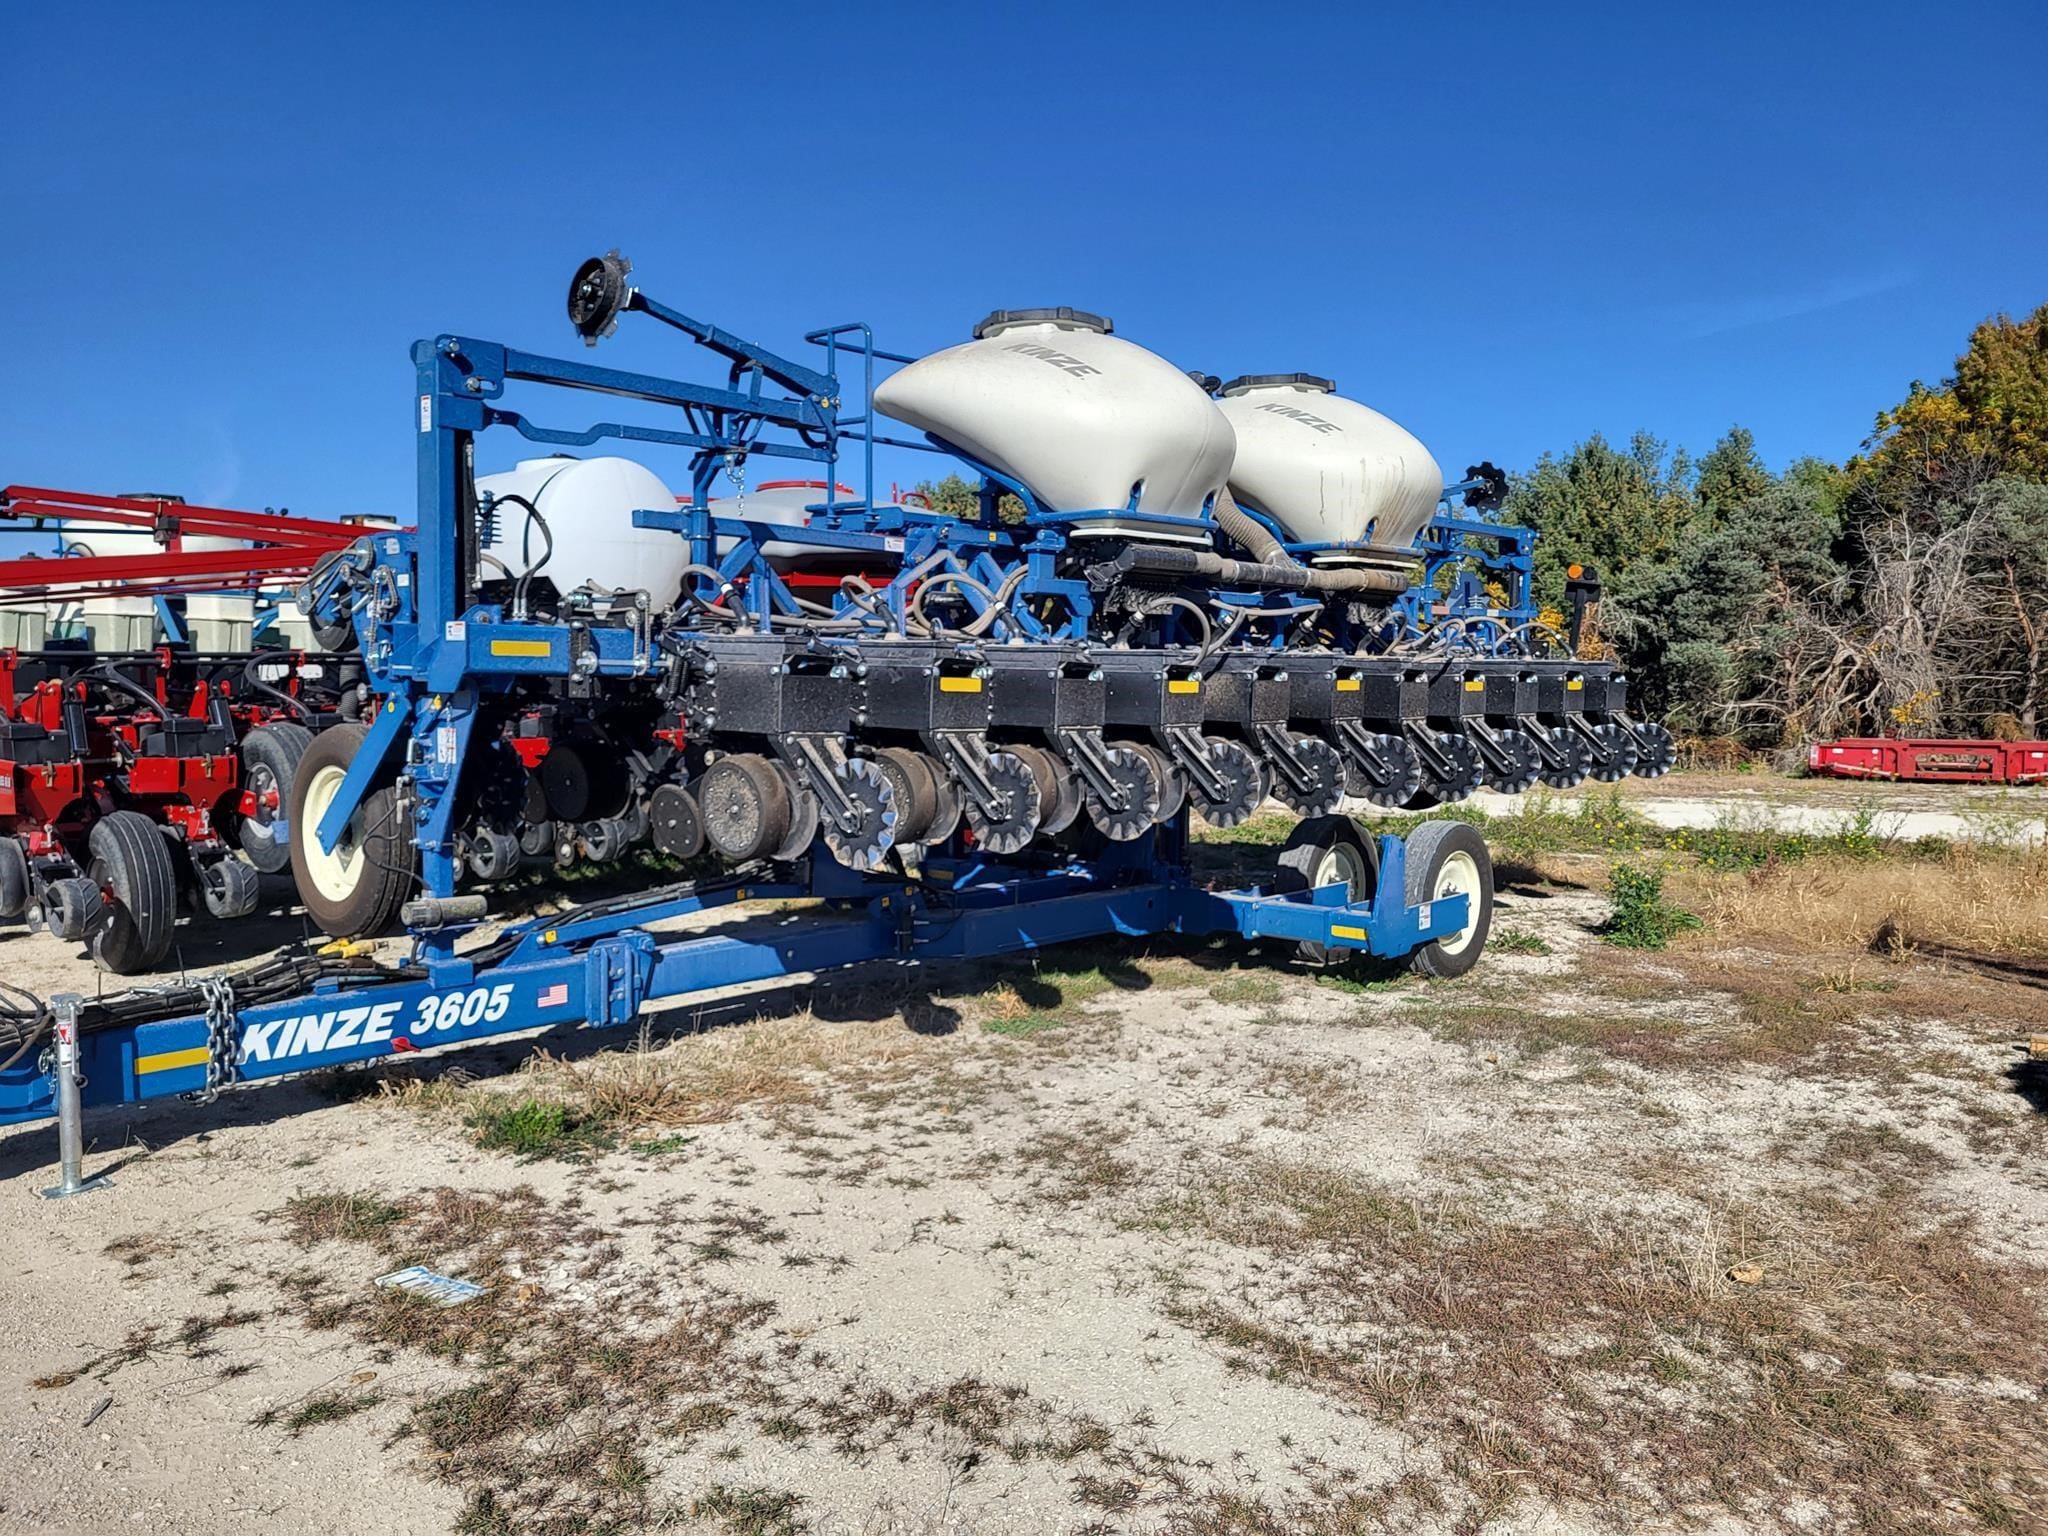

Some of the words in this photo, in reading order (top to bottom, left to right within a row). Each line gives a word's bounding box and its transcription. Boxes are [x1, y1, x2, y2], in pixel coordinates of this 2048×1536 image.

[1001, 343, 1102, 377] KINZE
[1254, 403, 1343, 433] KINZE
[240, 1001, 403, 1062] KINZE
[410, 984, 514, 1035] 3605
